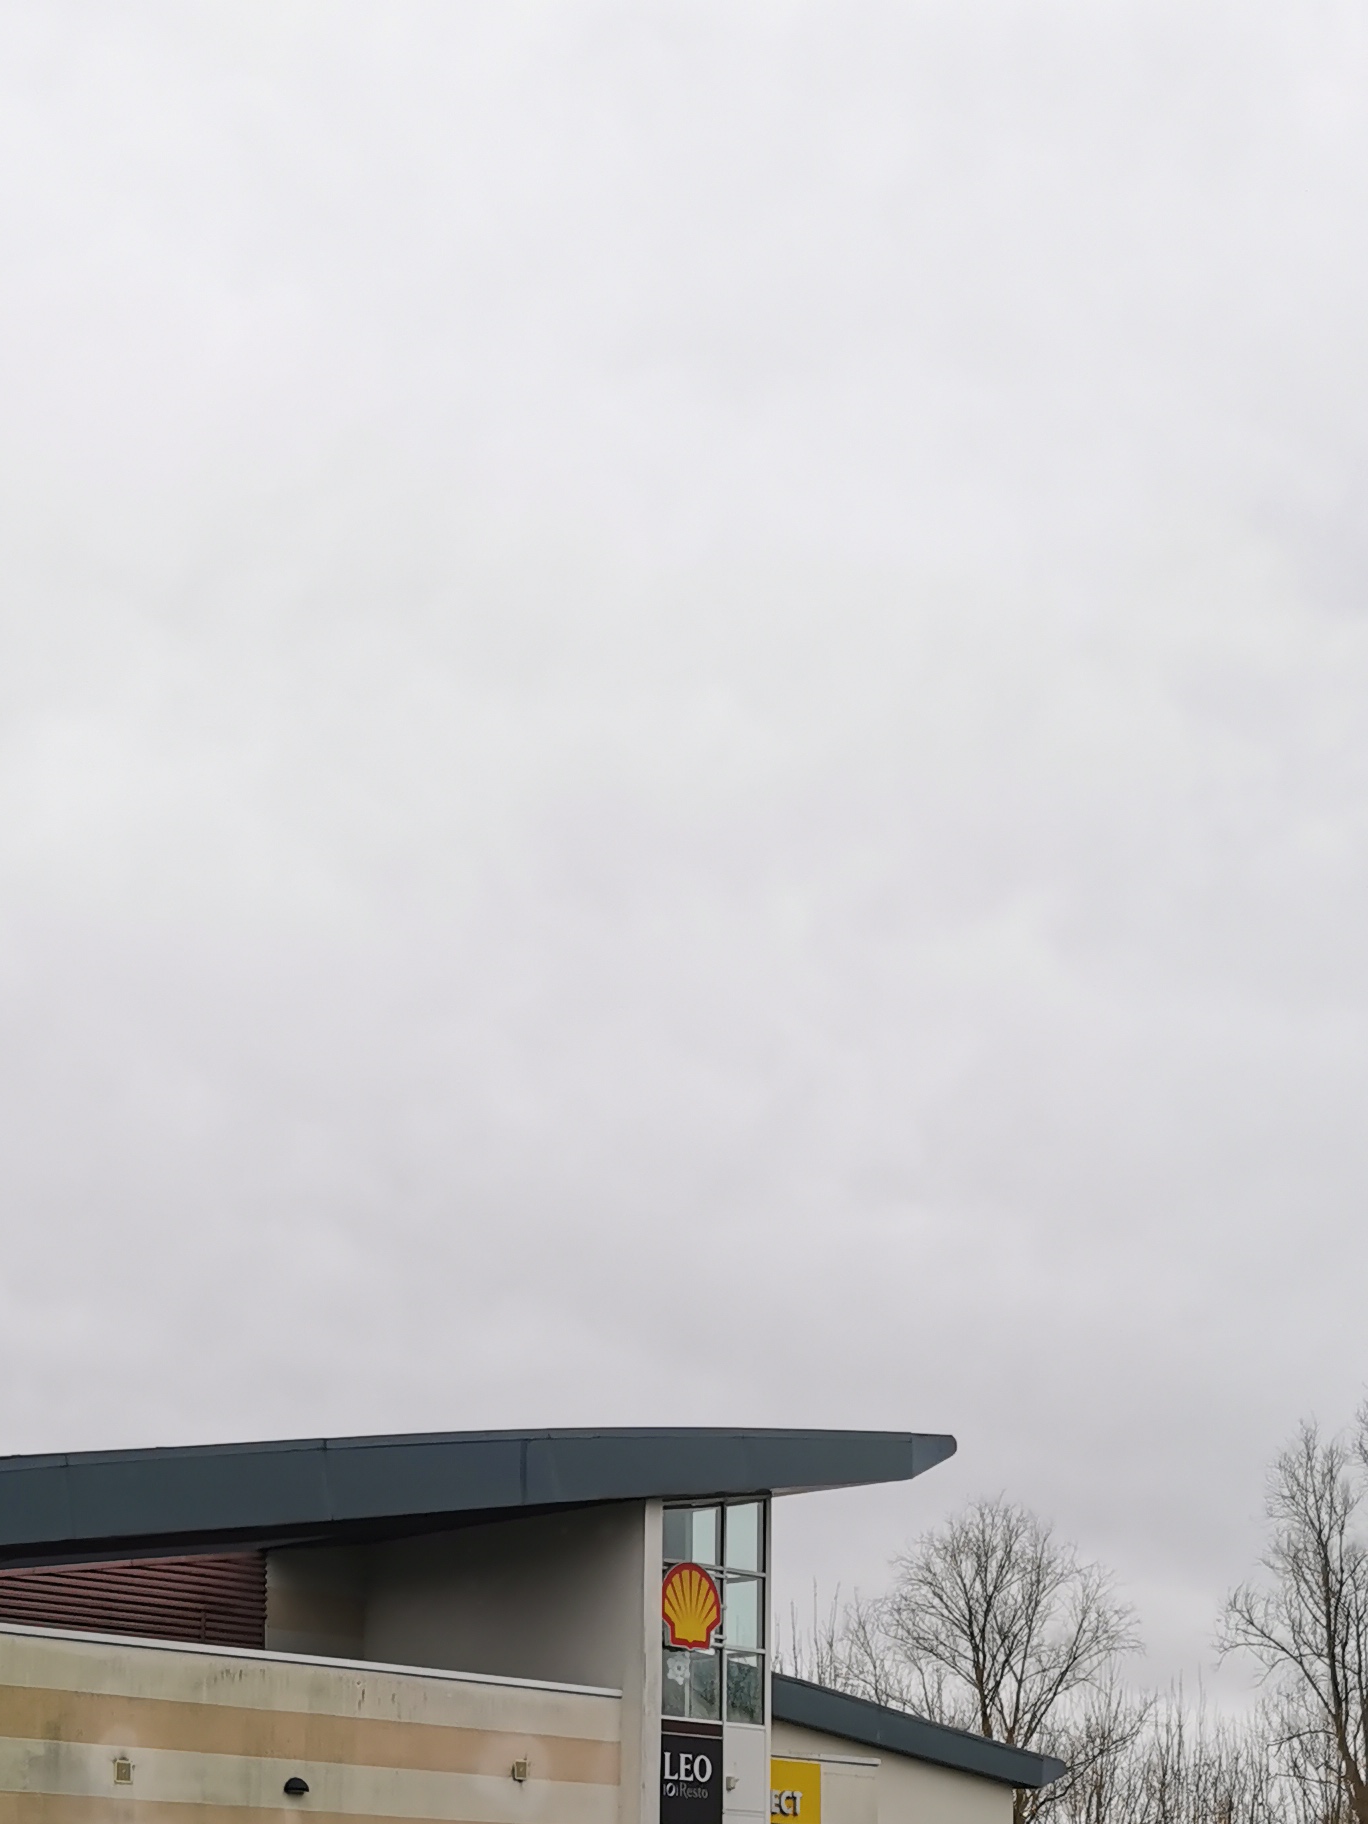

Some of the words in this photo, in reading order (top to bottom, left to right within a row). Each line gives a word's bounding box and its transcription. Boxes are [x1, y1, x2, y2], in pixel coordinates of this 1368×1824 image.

[663, 1751, 713, 1783] LEO
[679, 1782, 709, 1799] Resto
[770, 1790, 803, 1816] ECT
